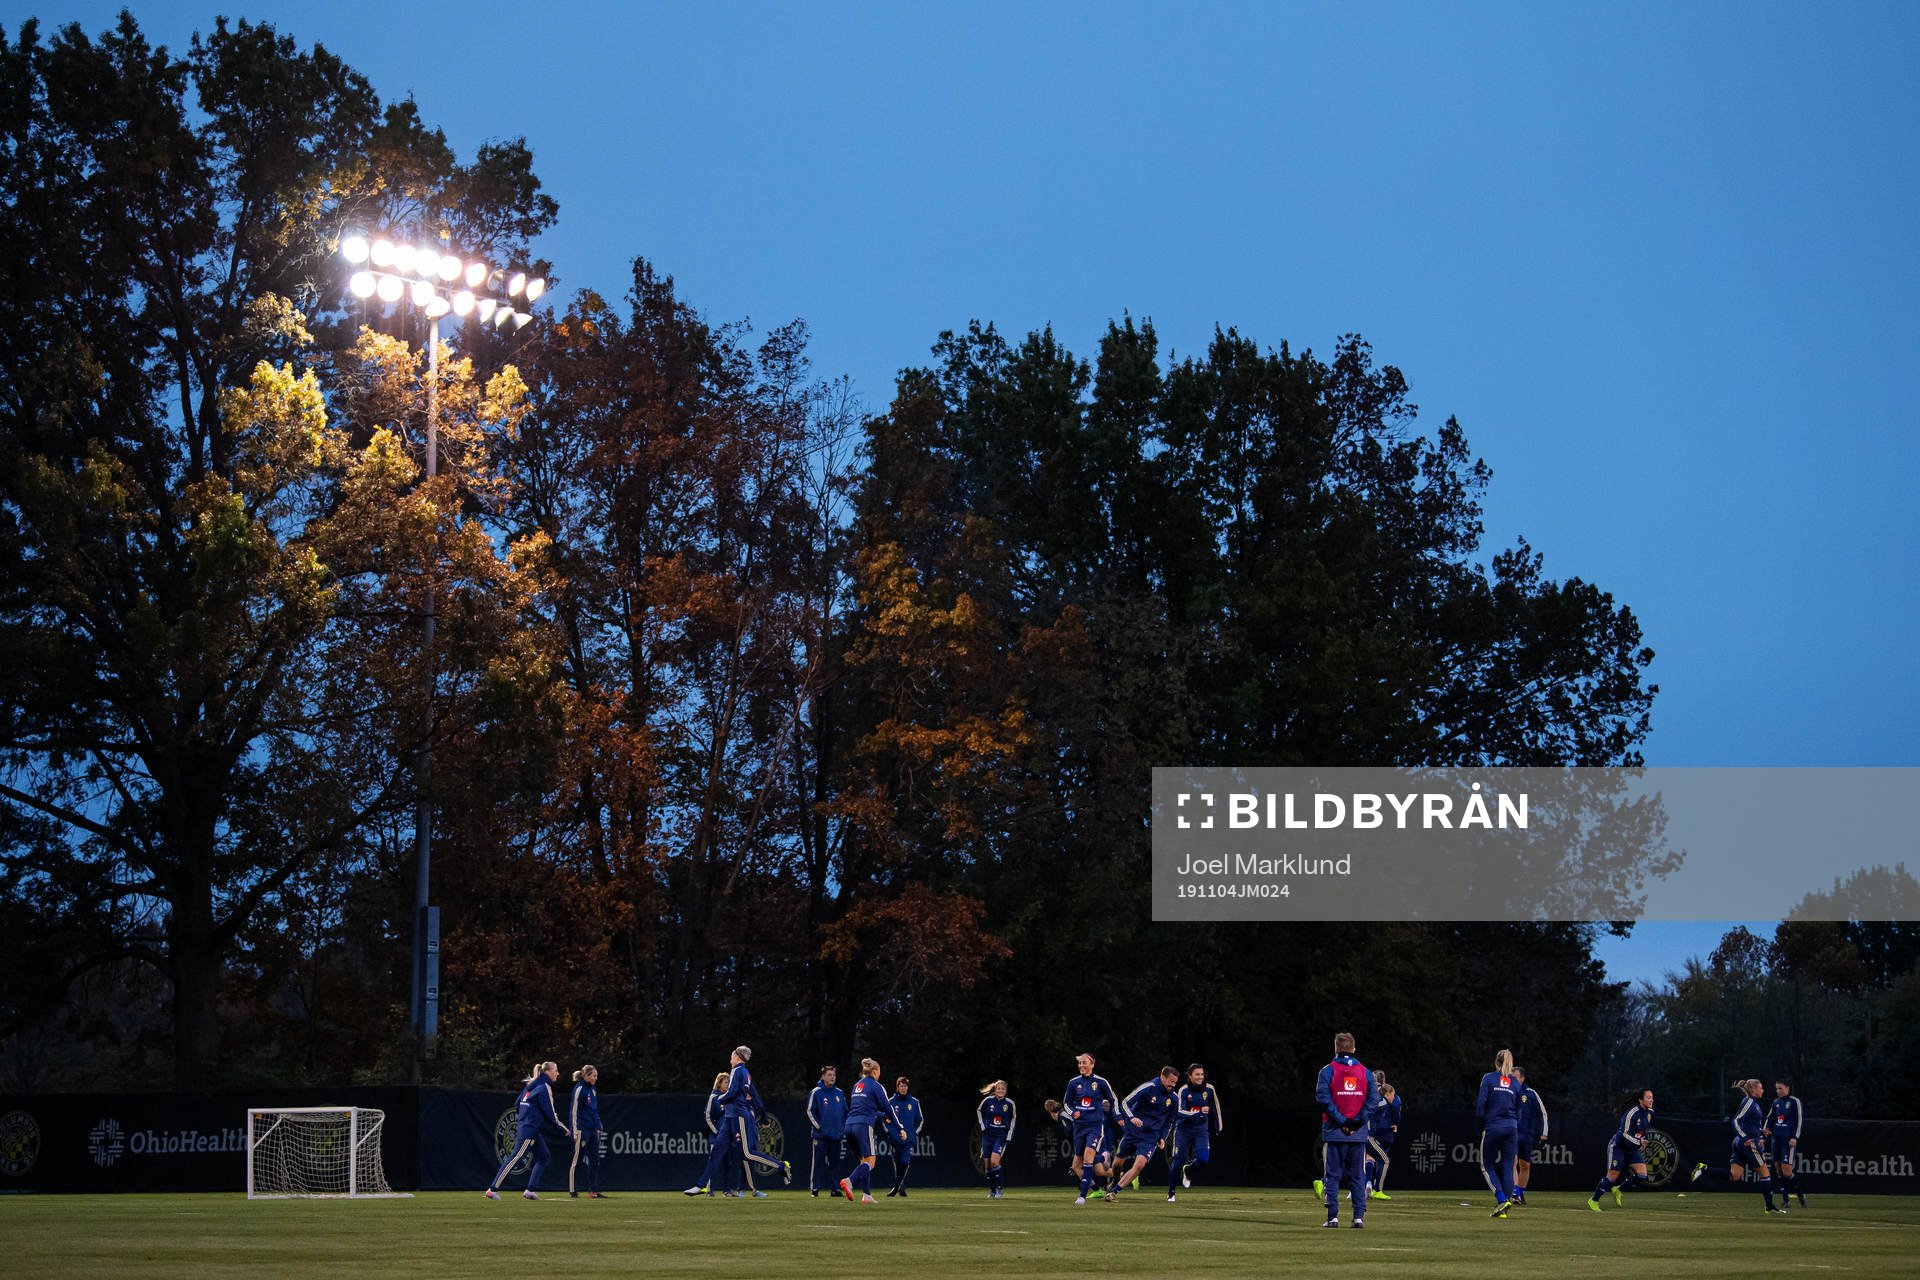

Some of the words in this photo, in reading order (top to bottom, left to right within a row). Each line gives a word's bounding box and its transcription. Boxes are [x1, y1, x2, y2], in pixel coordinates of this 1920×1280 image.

[130, 1127, 248, 1154] OhioHealth
[611, 1130, 709, 1154] OhioHealth
[1793, 1152, 1915, 1177] hioHealth
